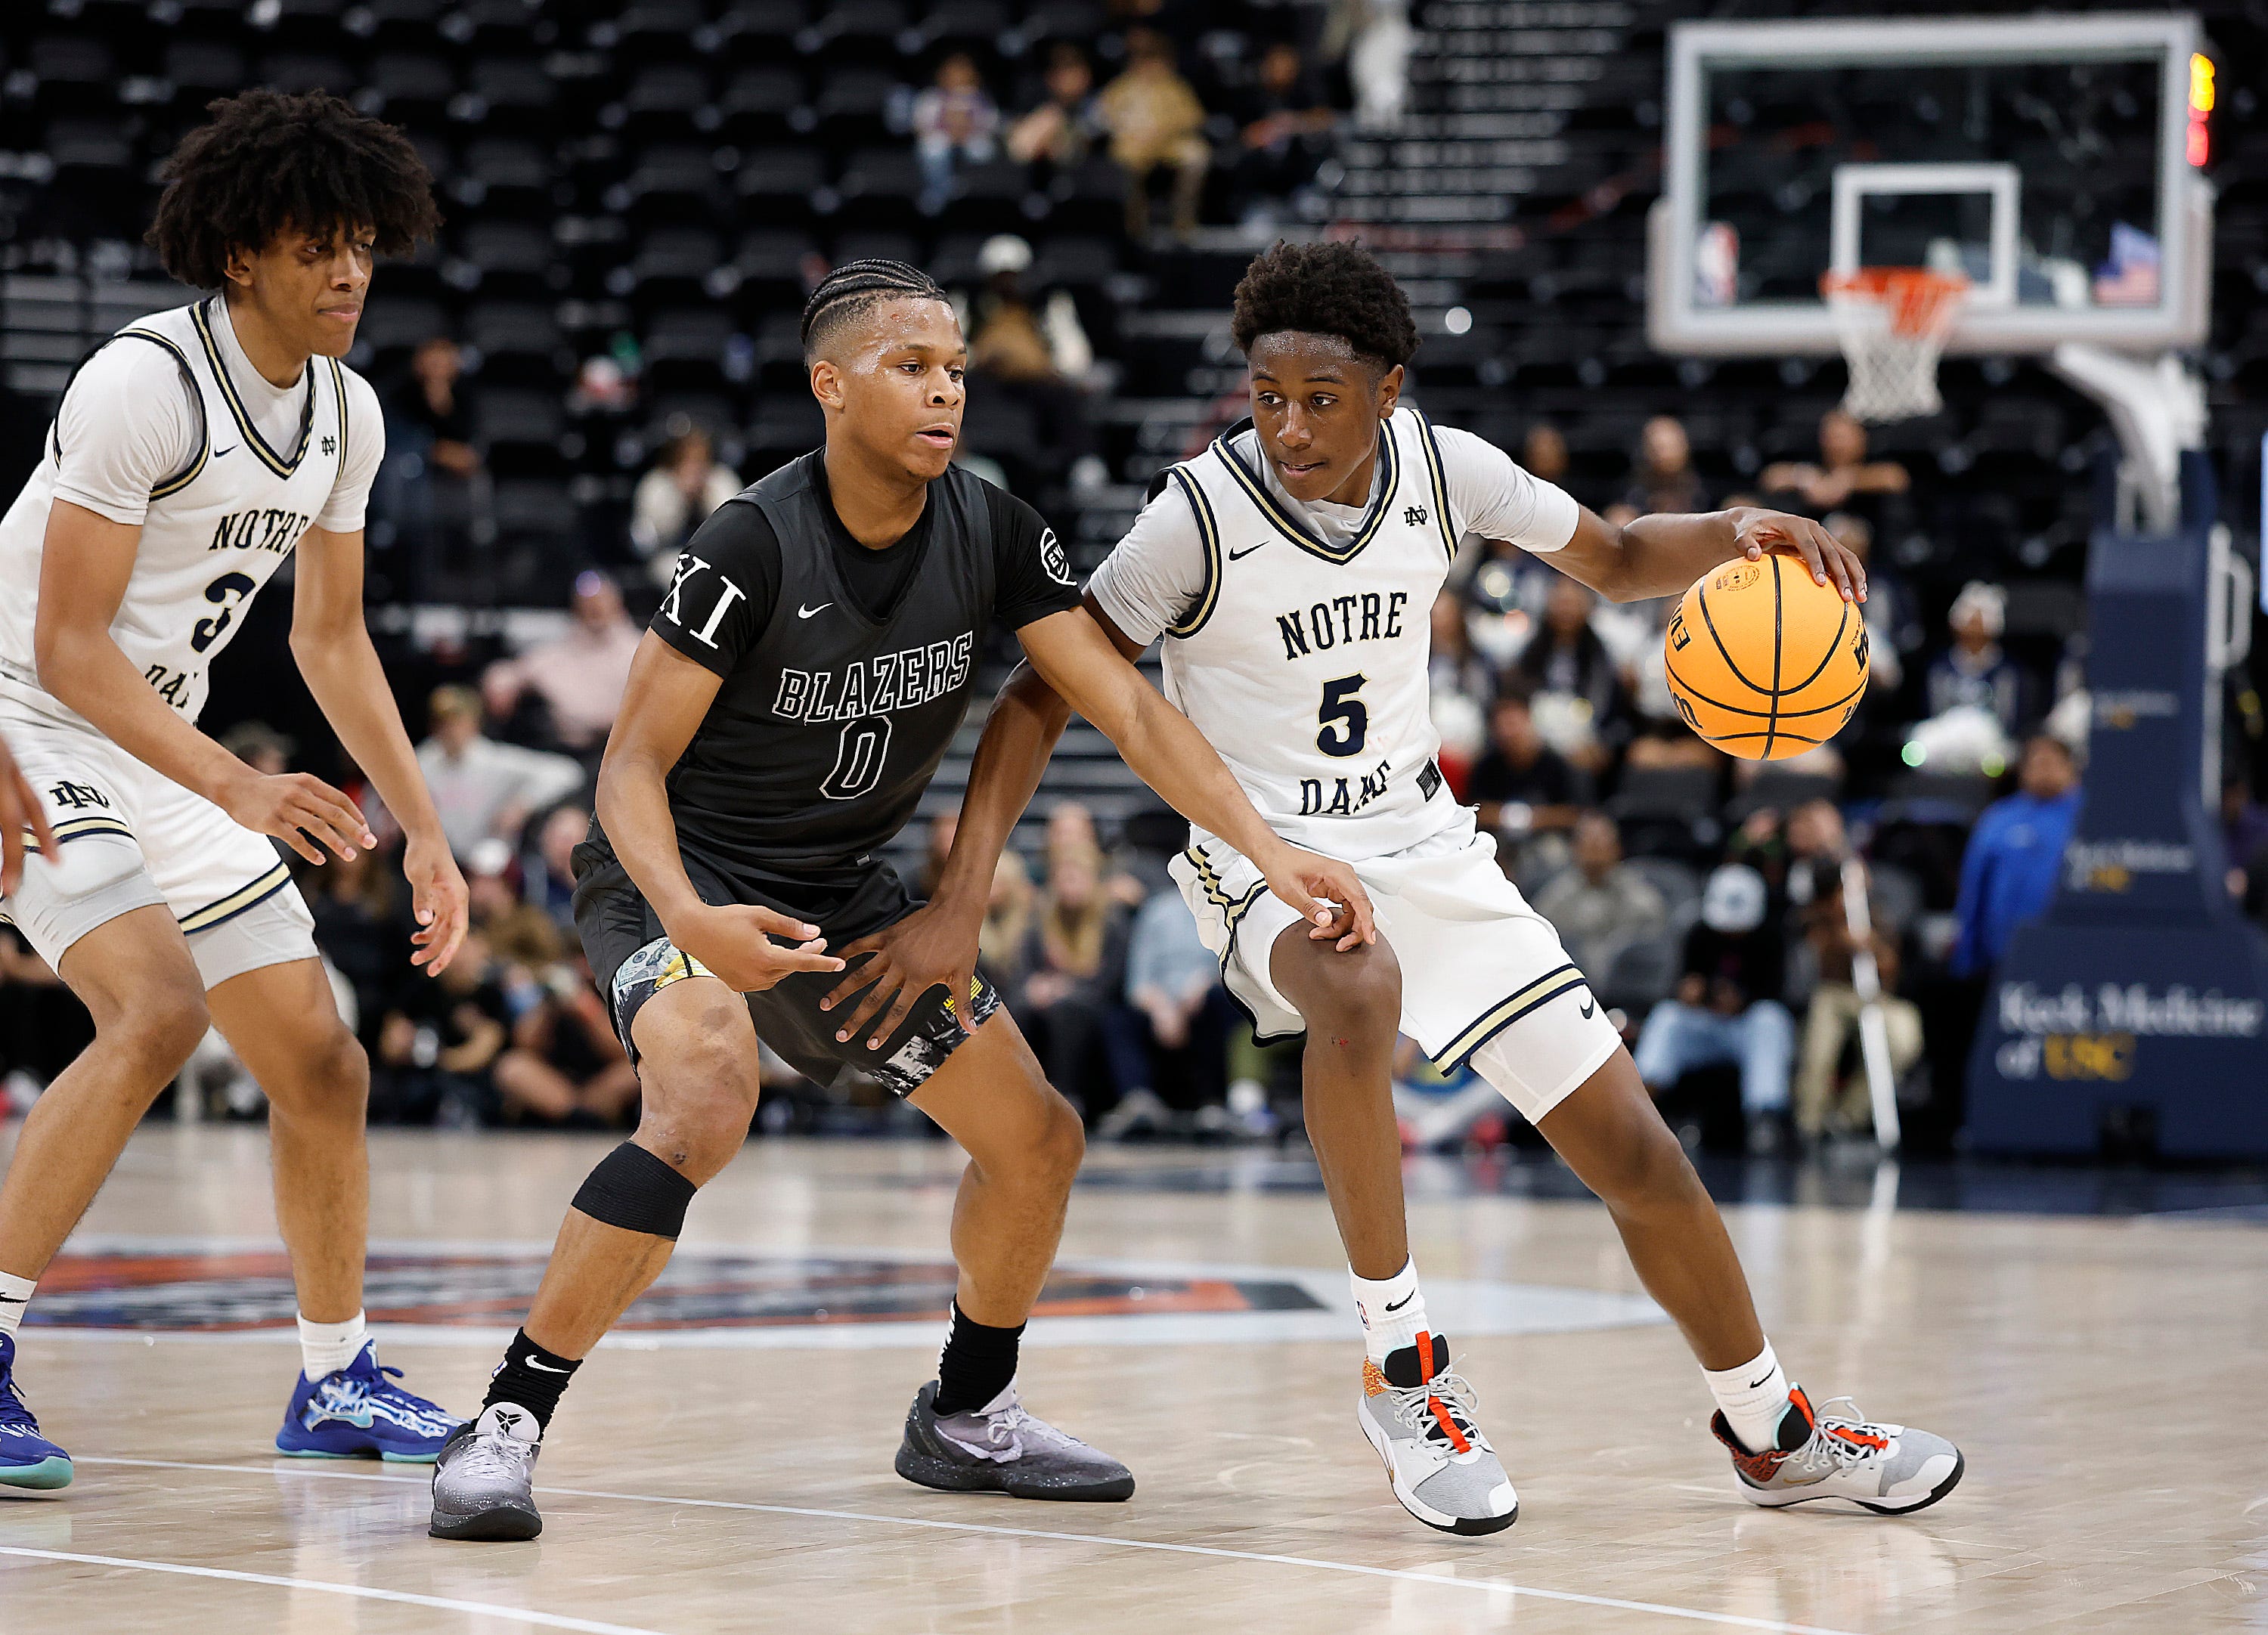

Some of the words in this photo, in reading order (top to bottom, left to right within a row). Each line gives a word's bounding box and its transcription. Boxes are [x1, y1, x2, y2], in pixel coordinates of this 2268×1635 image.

[190, 571, 258, 654] 3
[1275, 591, 1408, 661] NOTRE
[771, 630, 973, 726] BLAZERS
[1314, 670, 1371, 759] 5
[819, 714, 893, 800] 0
